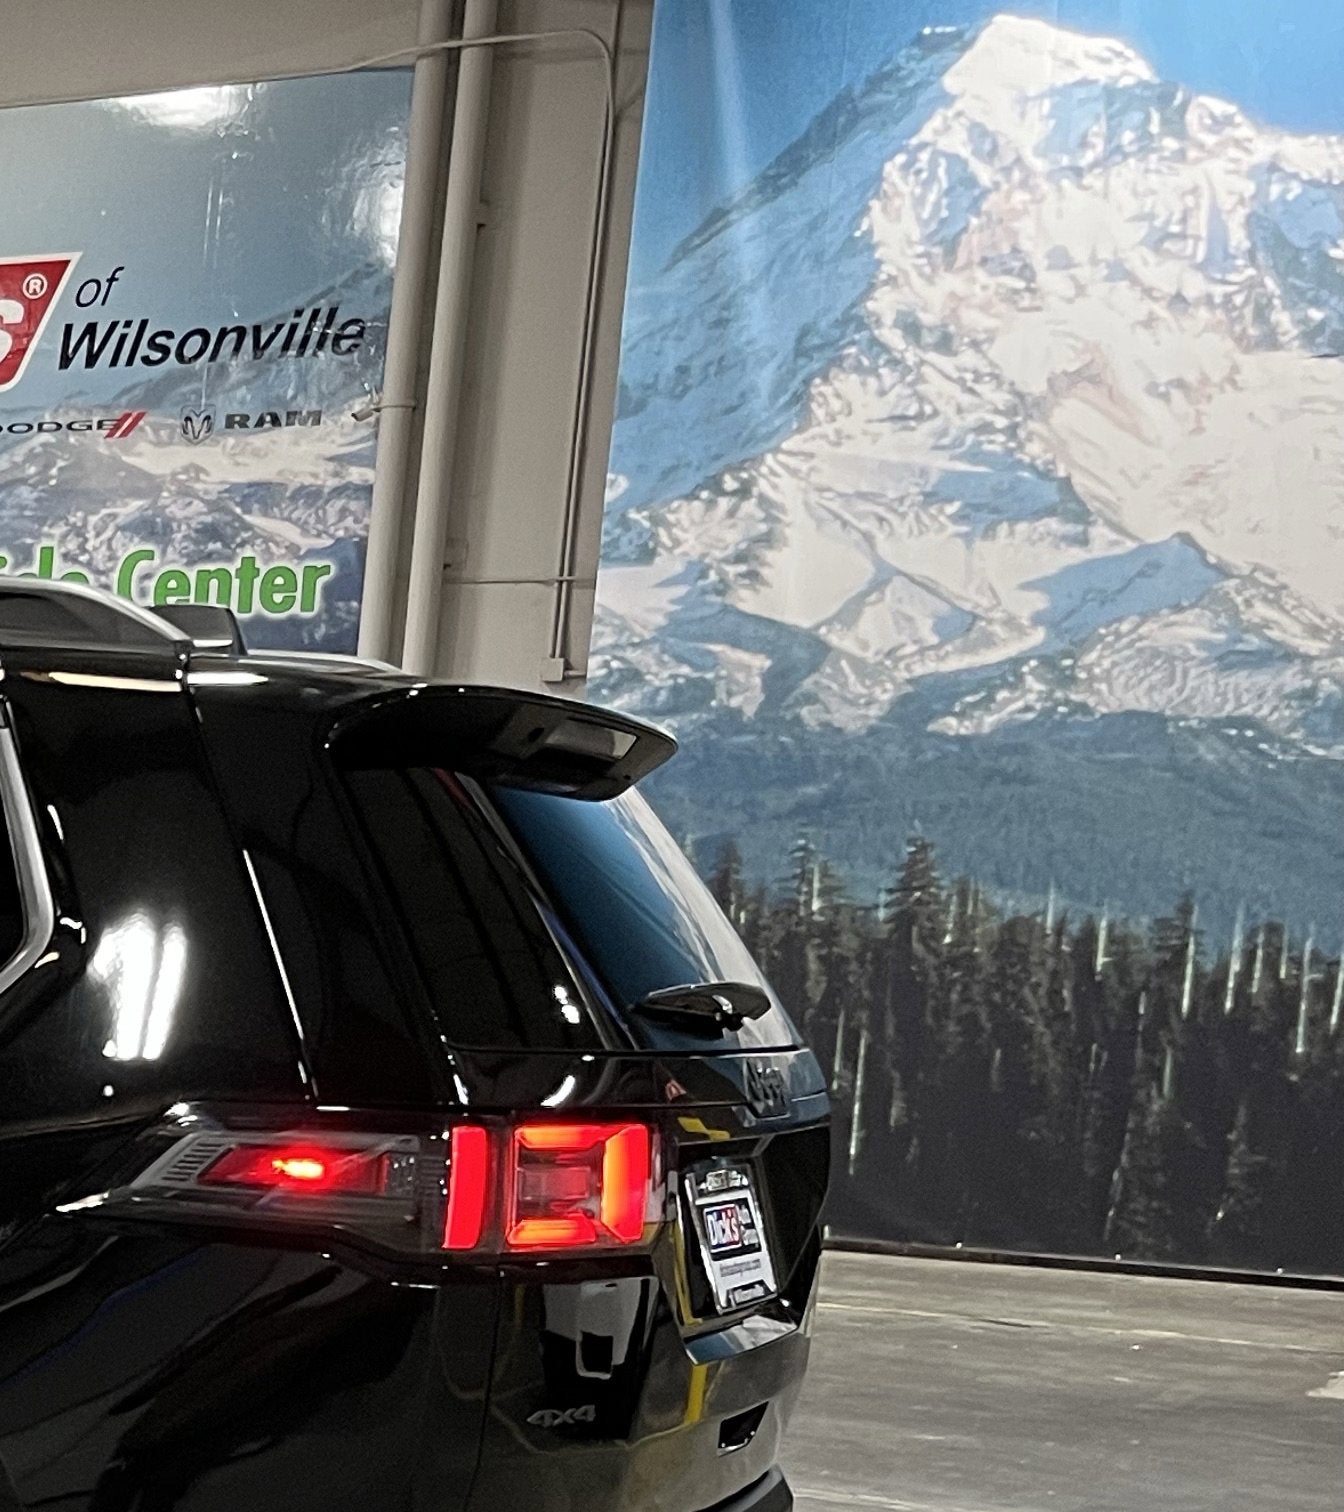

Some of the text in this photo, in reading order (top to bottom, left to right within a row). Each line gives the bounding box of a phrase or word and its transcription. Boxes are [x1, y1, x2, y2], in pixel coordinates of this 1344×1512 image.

[75, 266, 125, 308] of
[58, 304, 366, 371] Wilsonville
[224, 410, 322, 430] RAM
[117, 549, 331, 615] Center
